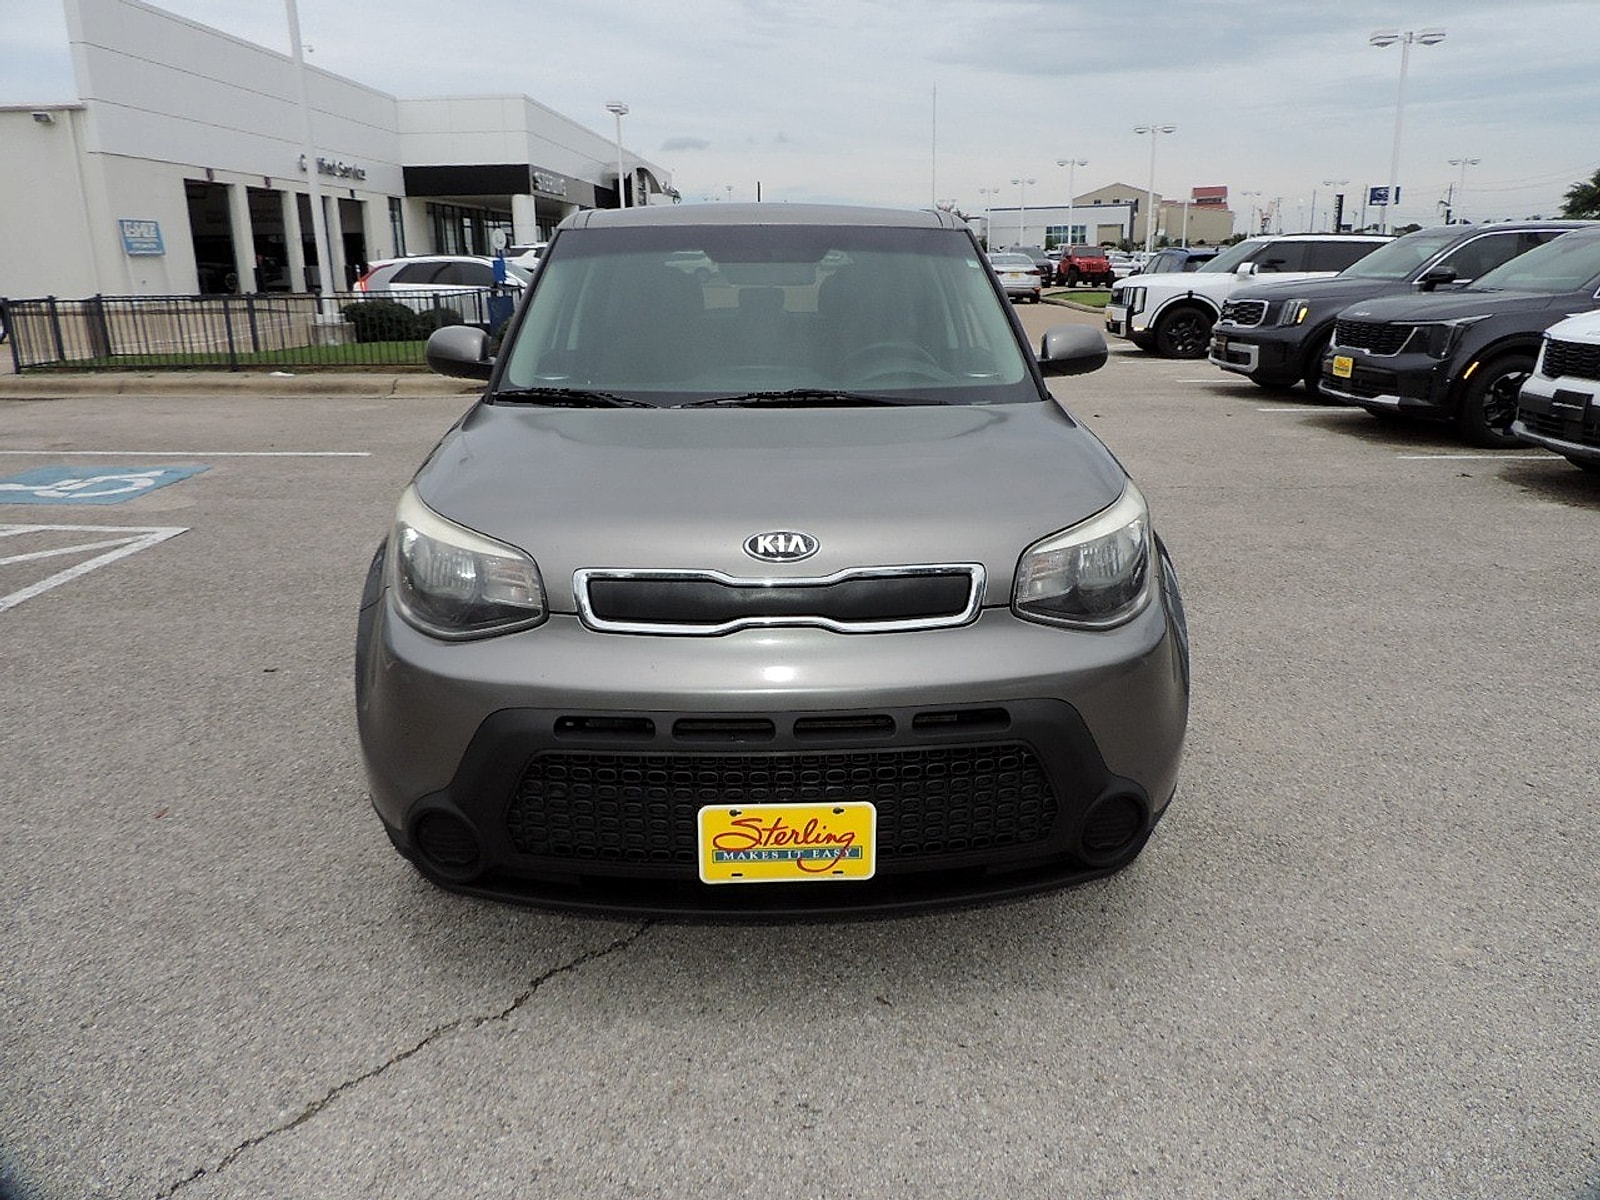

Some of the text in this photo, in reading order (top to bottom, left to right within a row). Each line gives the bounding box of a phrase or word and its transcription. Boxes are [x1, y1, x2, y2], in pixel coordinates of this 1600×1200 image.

[757, 534, 808, 553] KIA
[712, 816, 856, 873] Sterling
[722, 848, 852, 861] MAKES IT EASY
